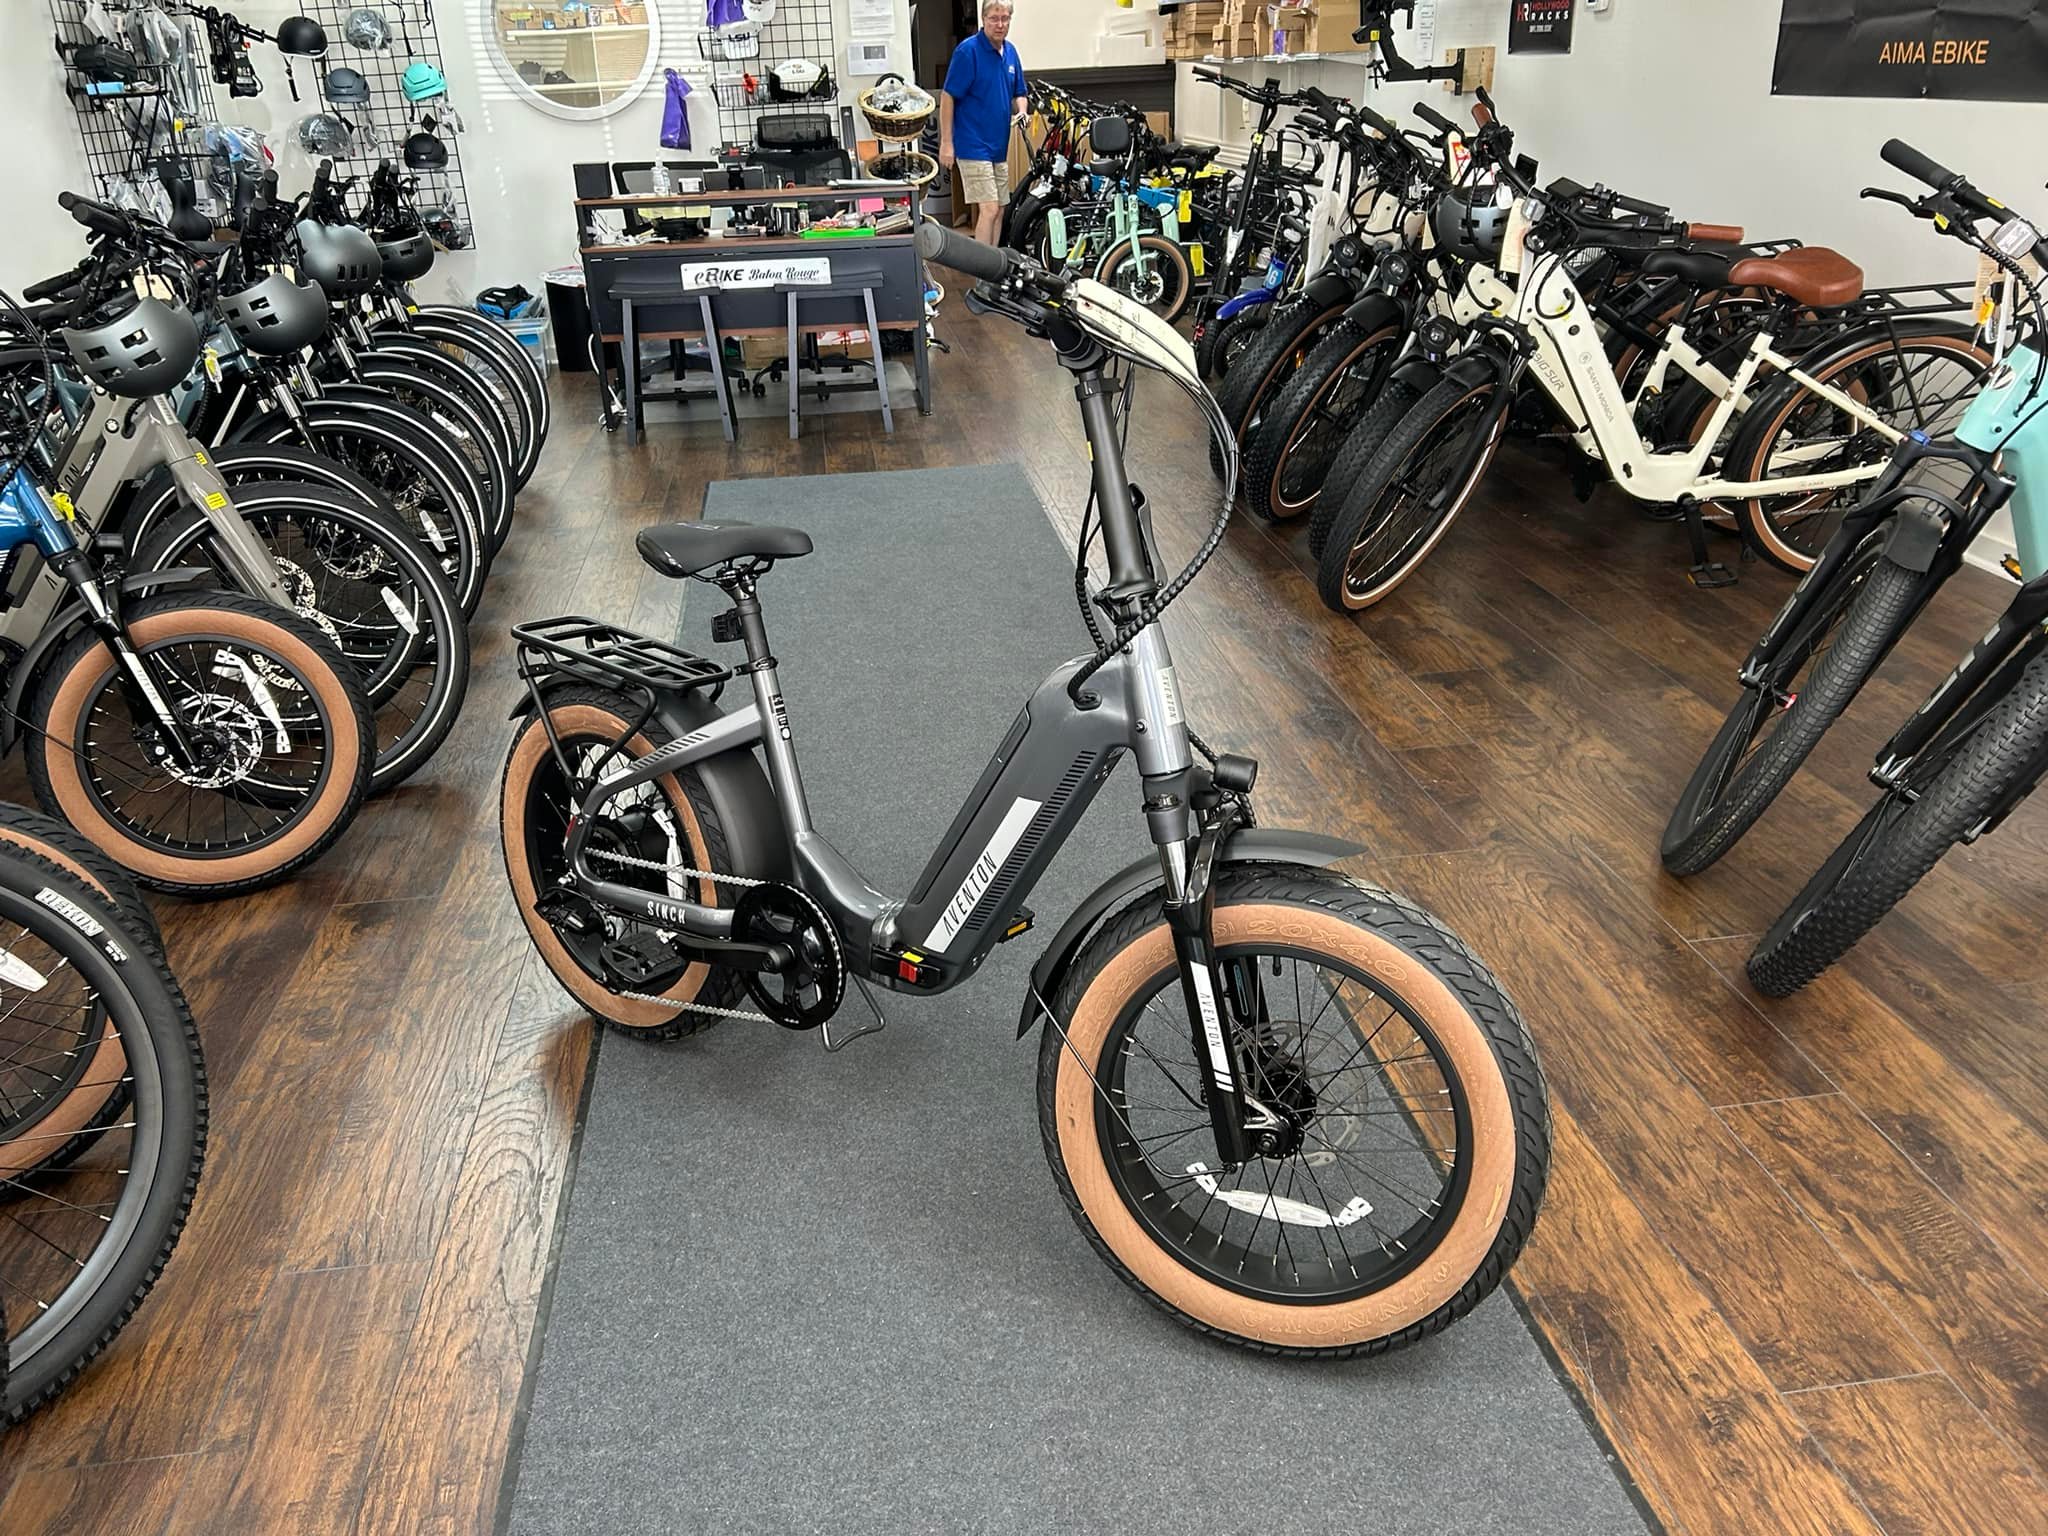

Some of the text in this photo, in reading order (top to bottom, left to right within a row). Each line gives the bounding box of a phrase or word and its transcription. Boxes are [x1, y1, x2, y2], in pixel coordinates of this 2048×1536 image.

[1531, 10, 1569, 21] RACKS
[728, 32, 750, 42] LSU
[1878, 39, 1990, 65] AIMA EBIKE
[694, 267, 745, 286] eBIKE
[785, 266, 820, 281] Rouge
[1268, 270, 1279, 285] 6
[1545, 368, 1565, 392] SUR
[1586, 366, 1615, 423] SANTA MONICA
[943, 851, 997, 936] AVENTON
[35, 887, 105, 936] REKON
[647, 900, 686, 924] SINCH
[1200, 992, 1222, 1047] AVENTON
